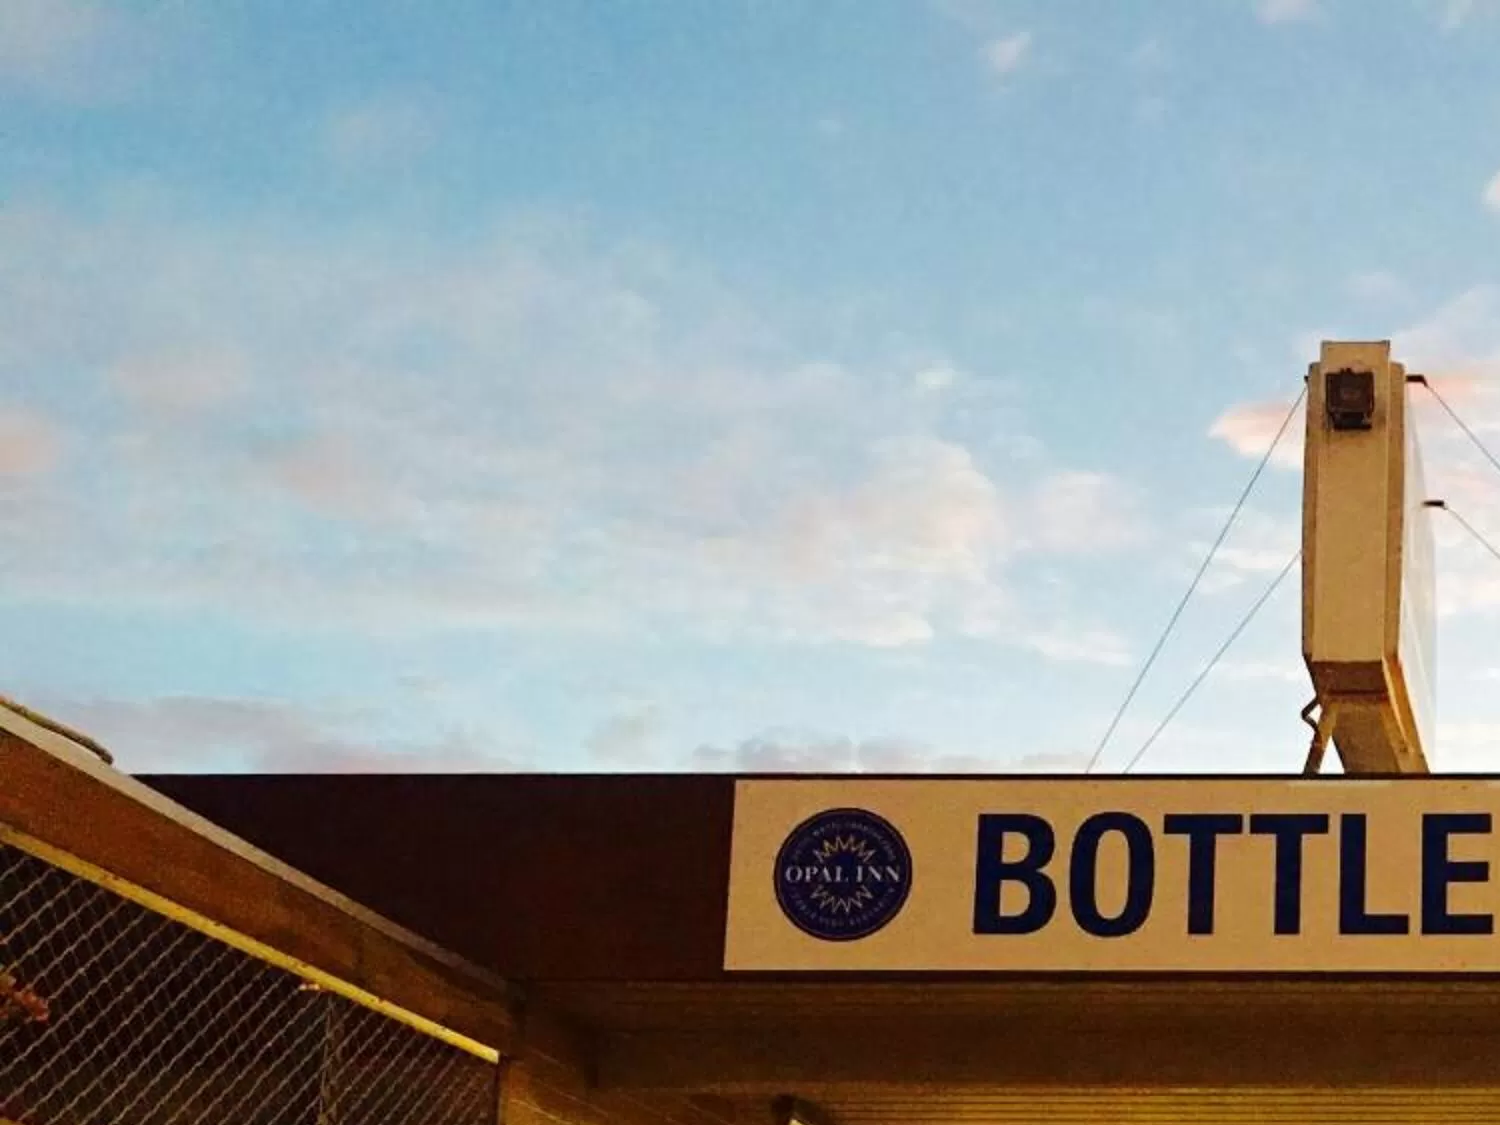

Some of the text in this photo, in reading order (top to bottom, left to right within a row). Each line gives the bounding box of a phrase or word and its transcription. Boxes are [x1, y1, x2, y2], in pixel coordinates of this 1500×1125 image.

[784, 865, 901, 883] OPAL INN
[973, 812, 1493, 937] BOTTLE
